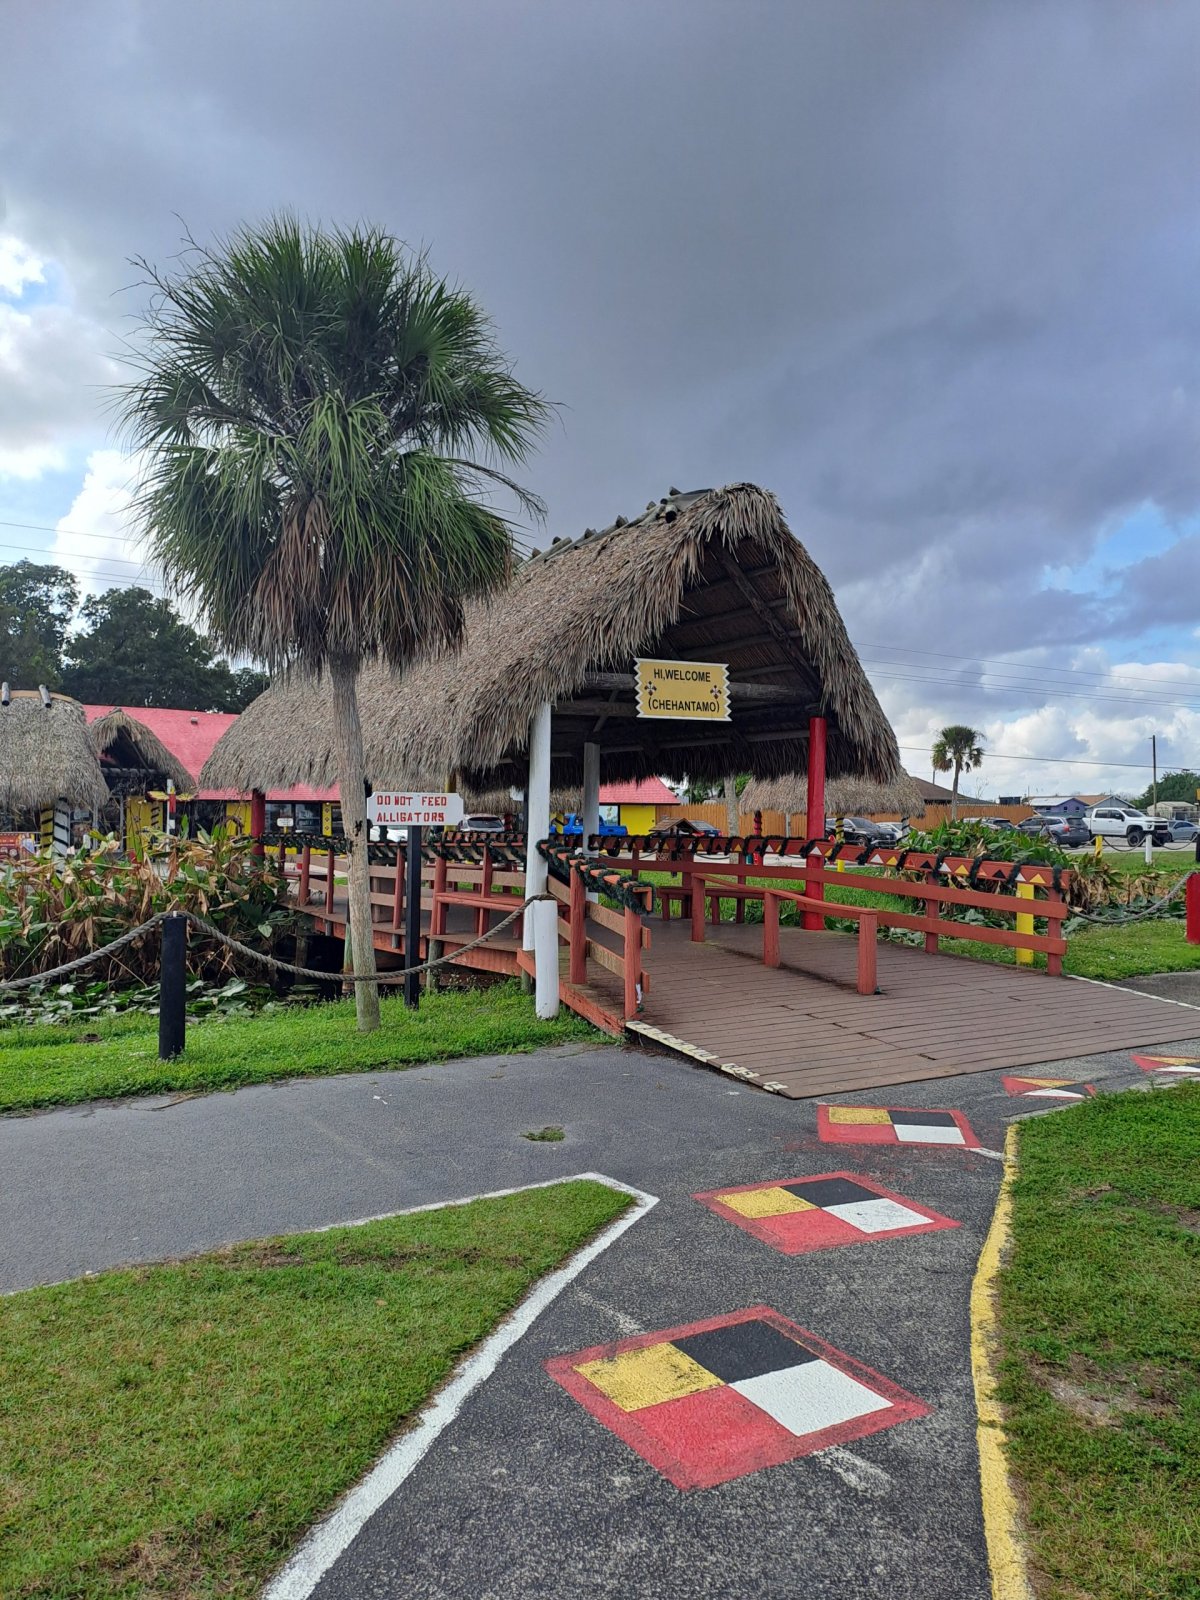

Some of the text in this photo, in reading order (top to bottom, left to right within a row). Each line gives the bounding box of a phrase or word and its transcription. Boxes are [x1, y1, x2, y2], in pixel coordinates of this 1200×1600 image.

[377, 795, 447, 806] DO NOT FEED
[376, 812, 445, 822] ALLIGATORS
